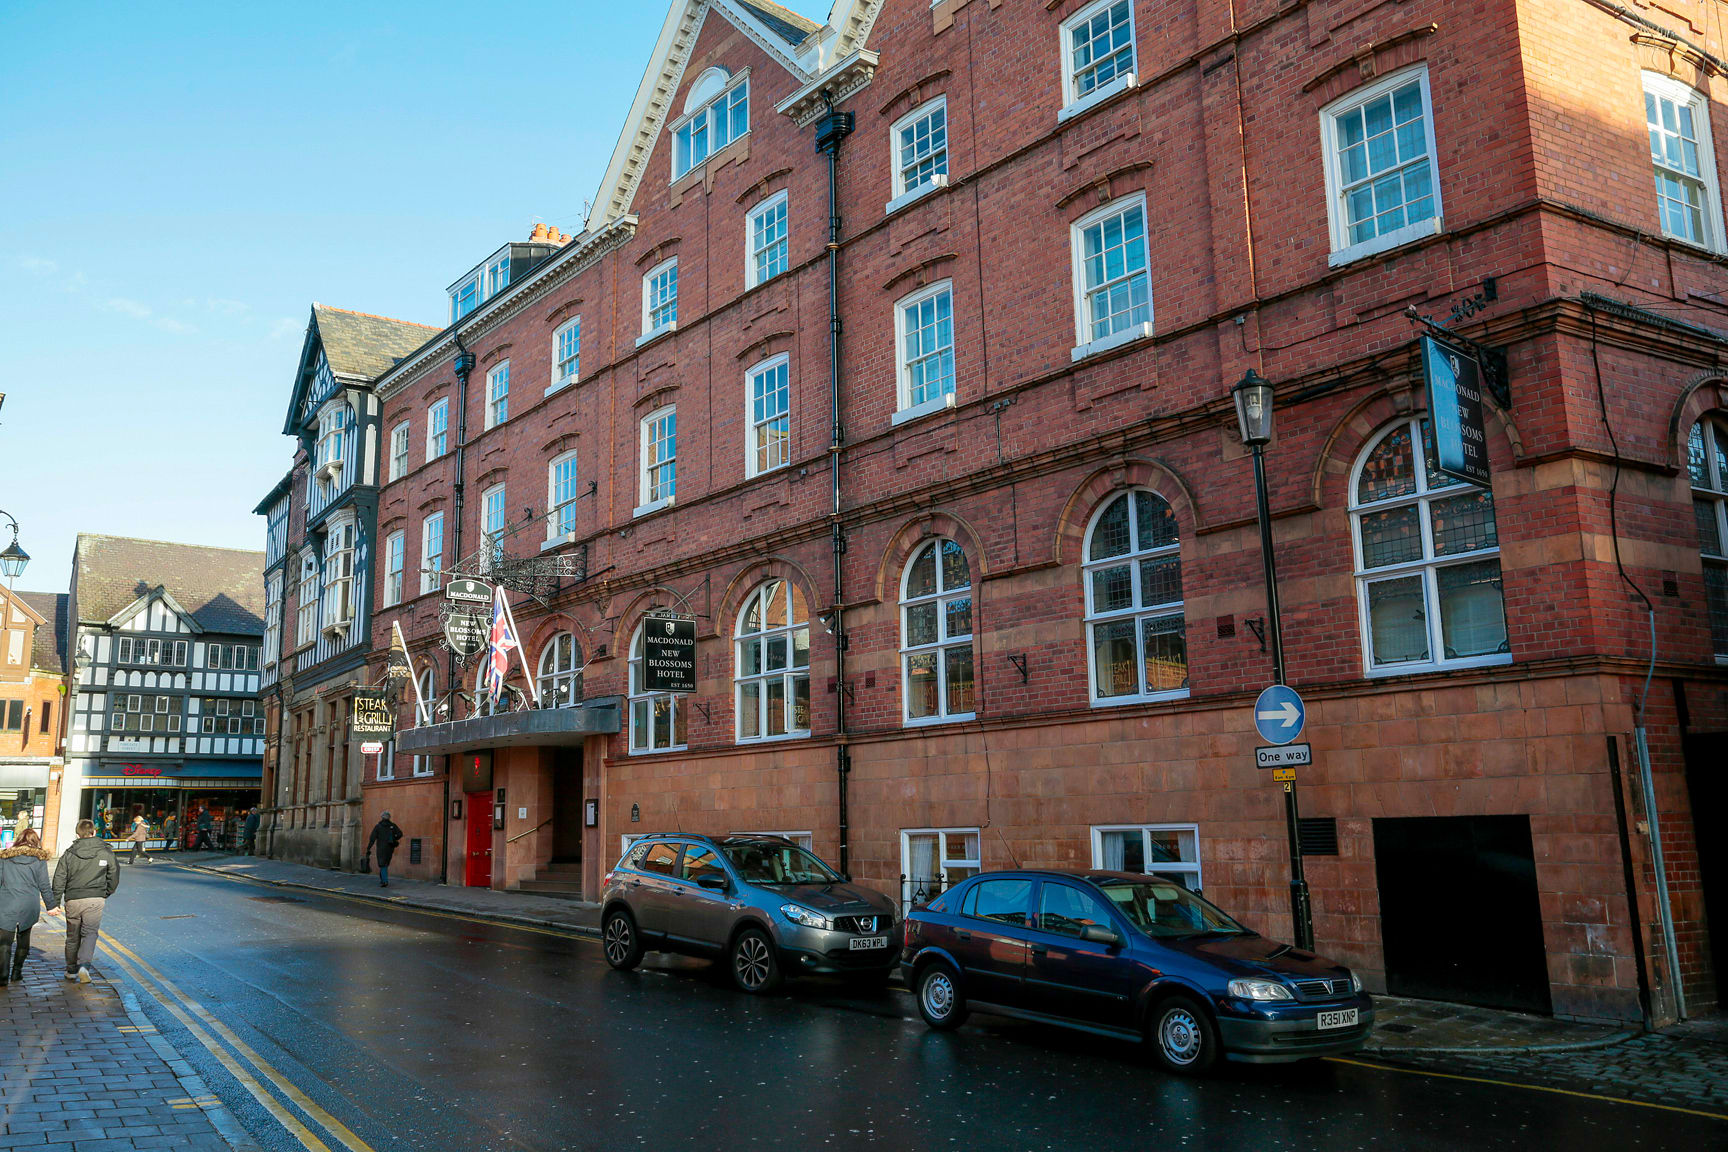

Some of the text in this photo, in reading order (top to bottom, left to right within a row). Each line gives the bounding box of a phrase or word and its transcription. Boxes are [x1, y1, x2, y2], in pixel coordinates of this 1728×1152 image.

[1441, 415, 1483, 442] BLSSOMS
[450, 591, 489, 600] MACDONALD
[450, 627, 486, 635] BLOSSOMS
[647, 636, 694, 646] MACDONALD
[661, 649, 680, 657] NEW
[649, 659, 693, 668] BLOSSOMS
[657, 670, 685, 679] HOTEL
[358, 698, 388, 711] STEAK
[364, 711, 389, 725] GRILL
[1259, 751, 1307, 762] One way
[120, 763, 162, 779] Disney
[1284, 782, 1290, 791] 2
[853, 939, 871, 948] DK63
[1321, 1013, 1341, 1027] R351
